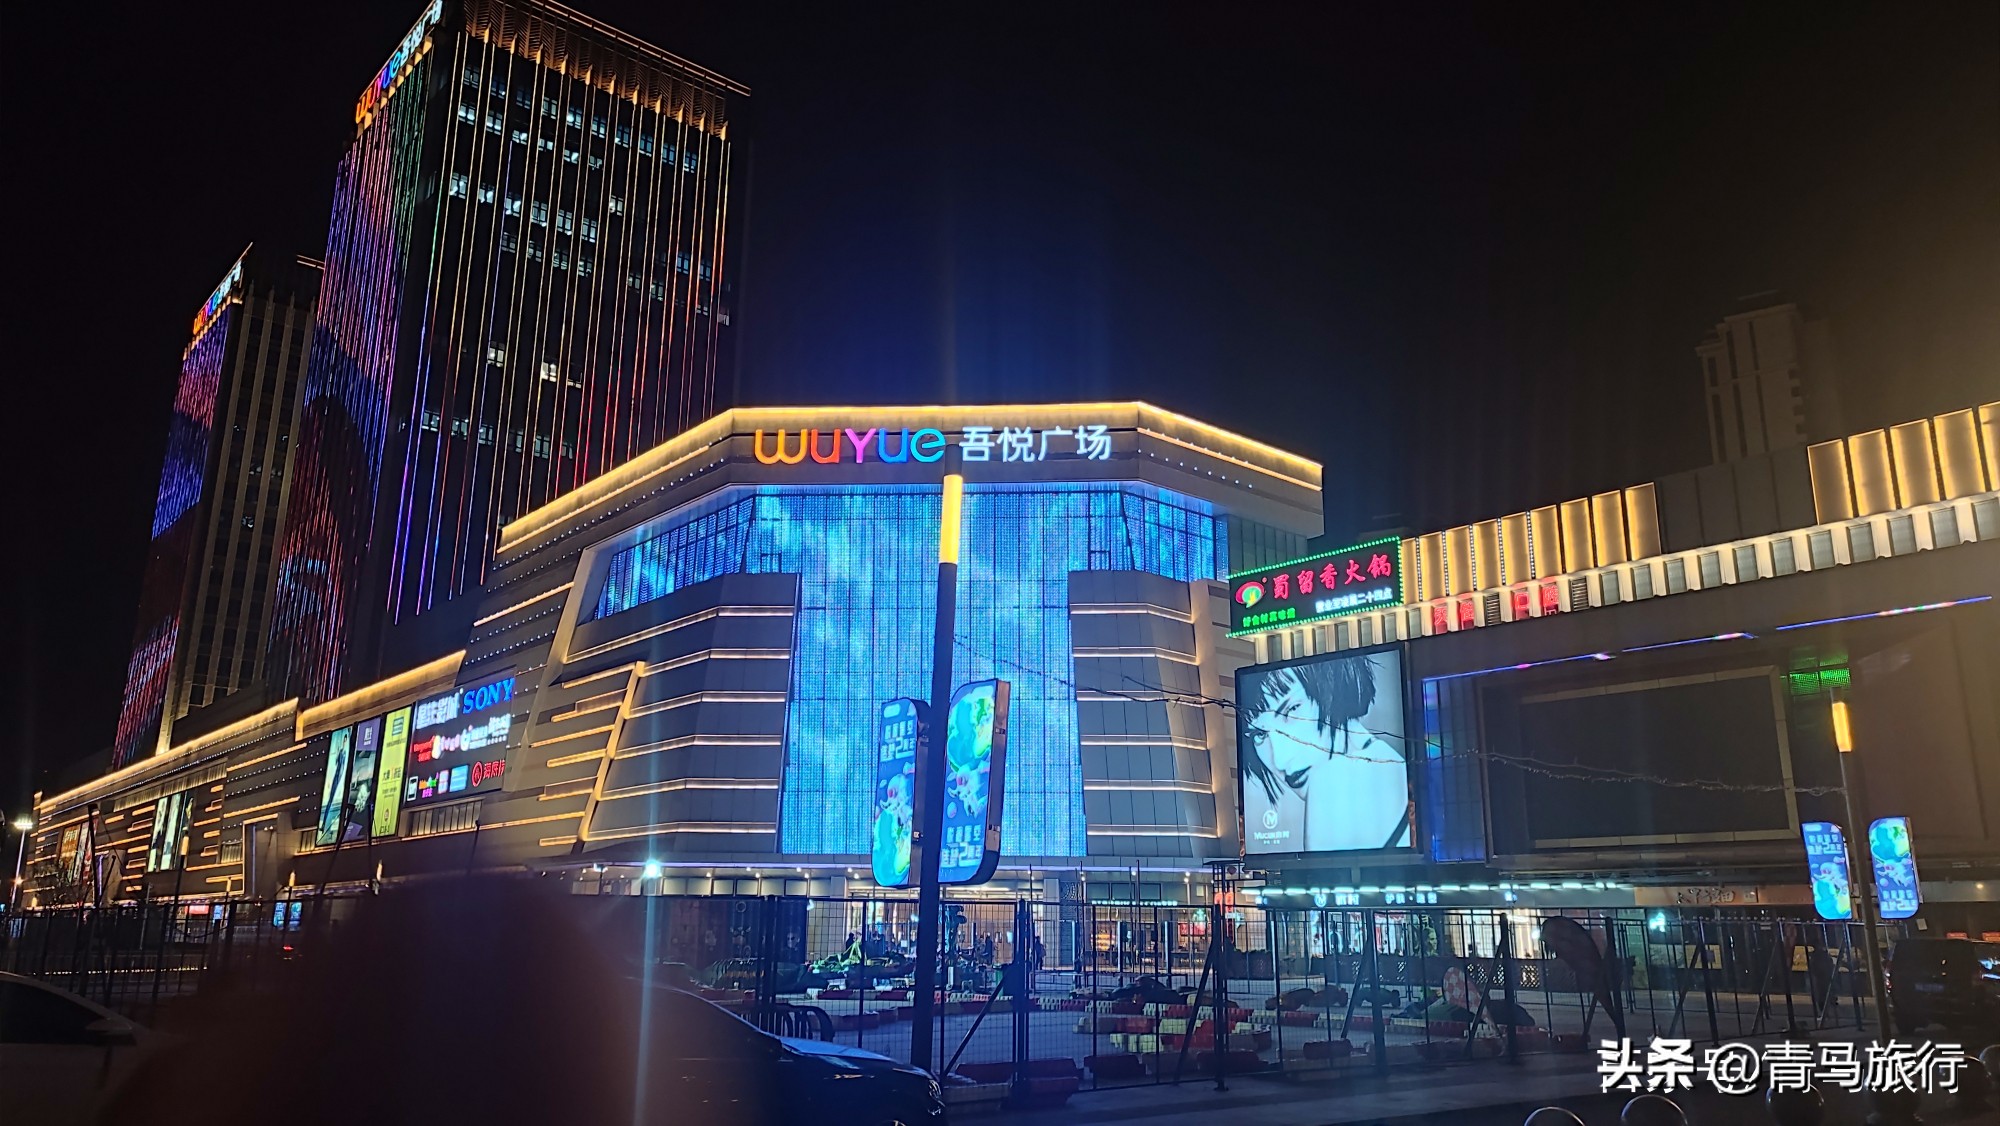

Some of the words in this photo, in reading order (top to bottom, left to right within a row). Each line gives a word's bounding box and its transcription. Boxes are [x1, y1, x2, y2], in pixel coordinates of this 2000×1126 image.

[958, 424, 1112, 463] 吾悦广场
[1272, 553, 1392, 600] 蜀留香火锅
[463, 678, 515, 713] SONY
